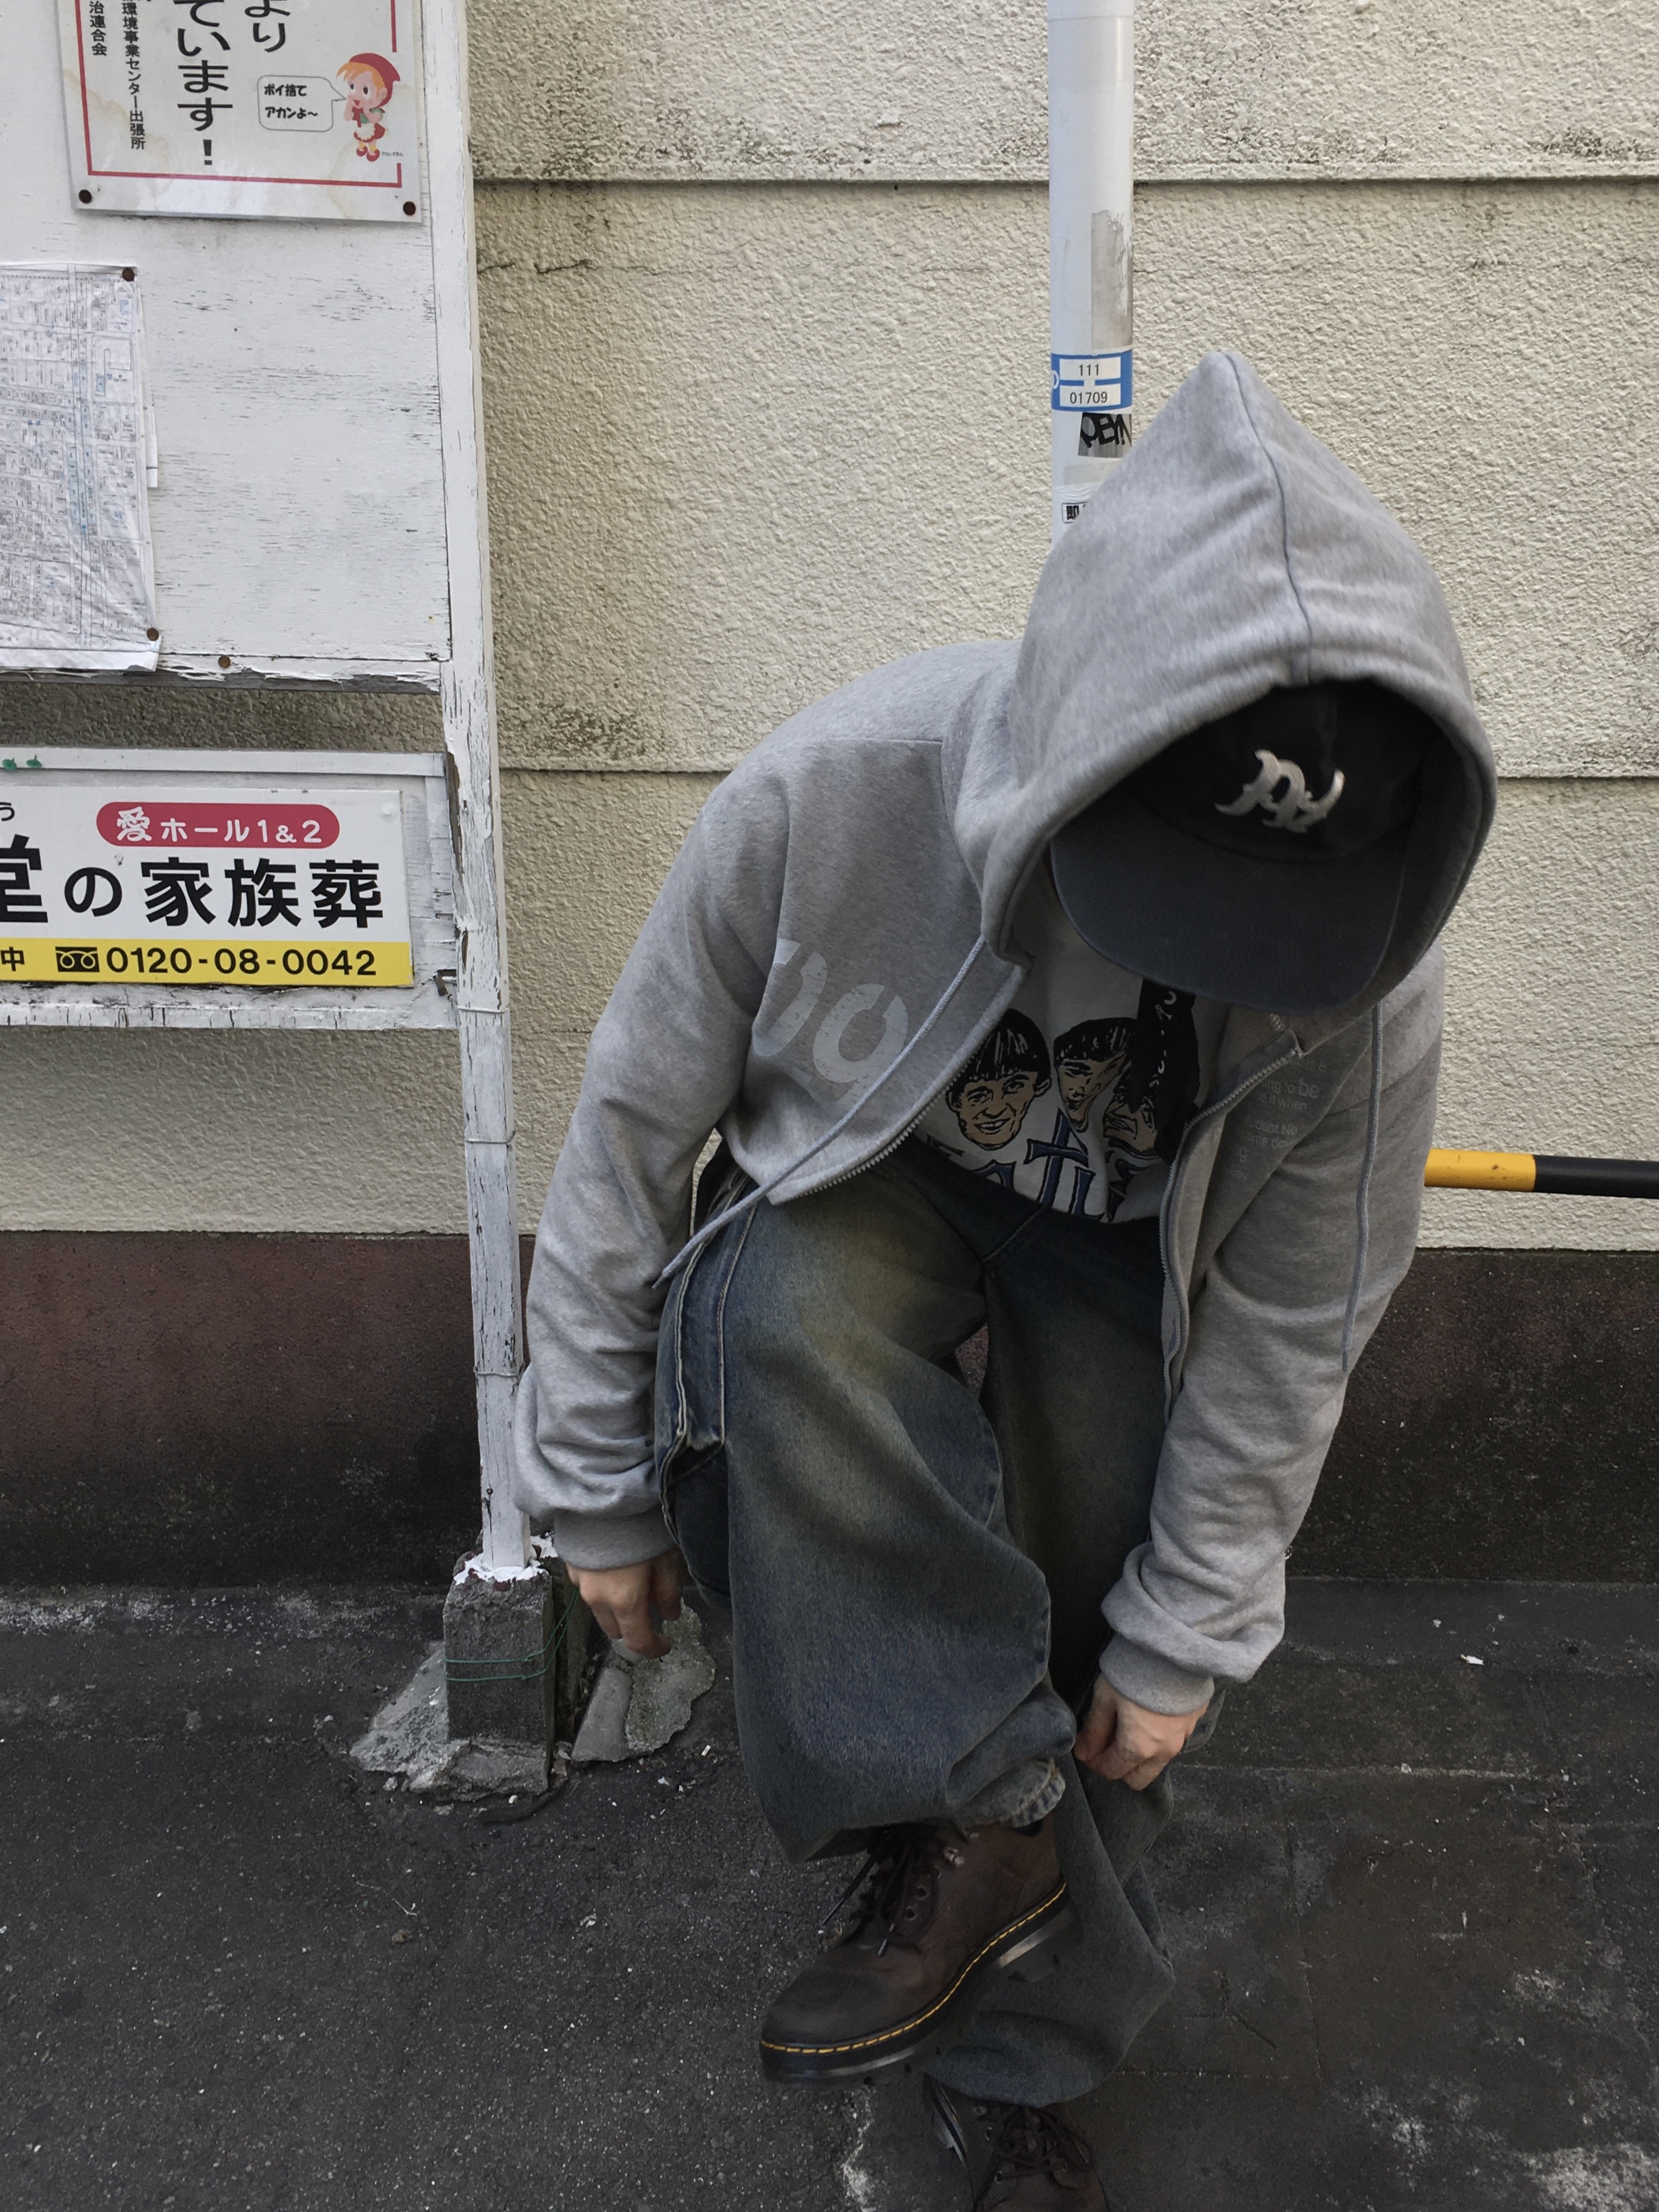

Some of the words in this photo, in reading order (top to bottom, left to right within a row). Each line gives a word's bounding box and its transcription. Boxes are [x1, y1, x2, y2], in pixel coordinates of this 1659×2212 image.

[89, 1, 107, 56] 治連合会
[244, 0, 291, 53] より
[121, 0, 145, 150] 環境事業センター出張所
[264, 83, 307, 96] ポイ捨て
[1079, 364, 1100, 376] 111
[1069, 392, 1108, 404] 01709
[107, 947, 377, 975] 0120-08-0042
